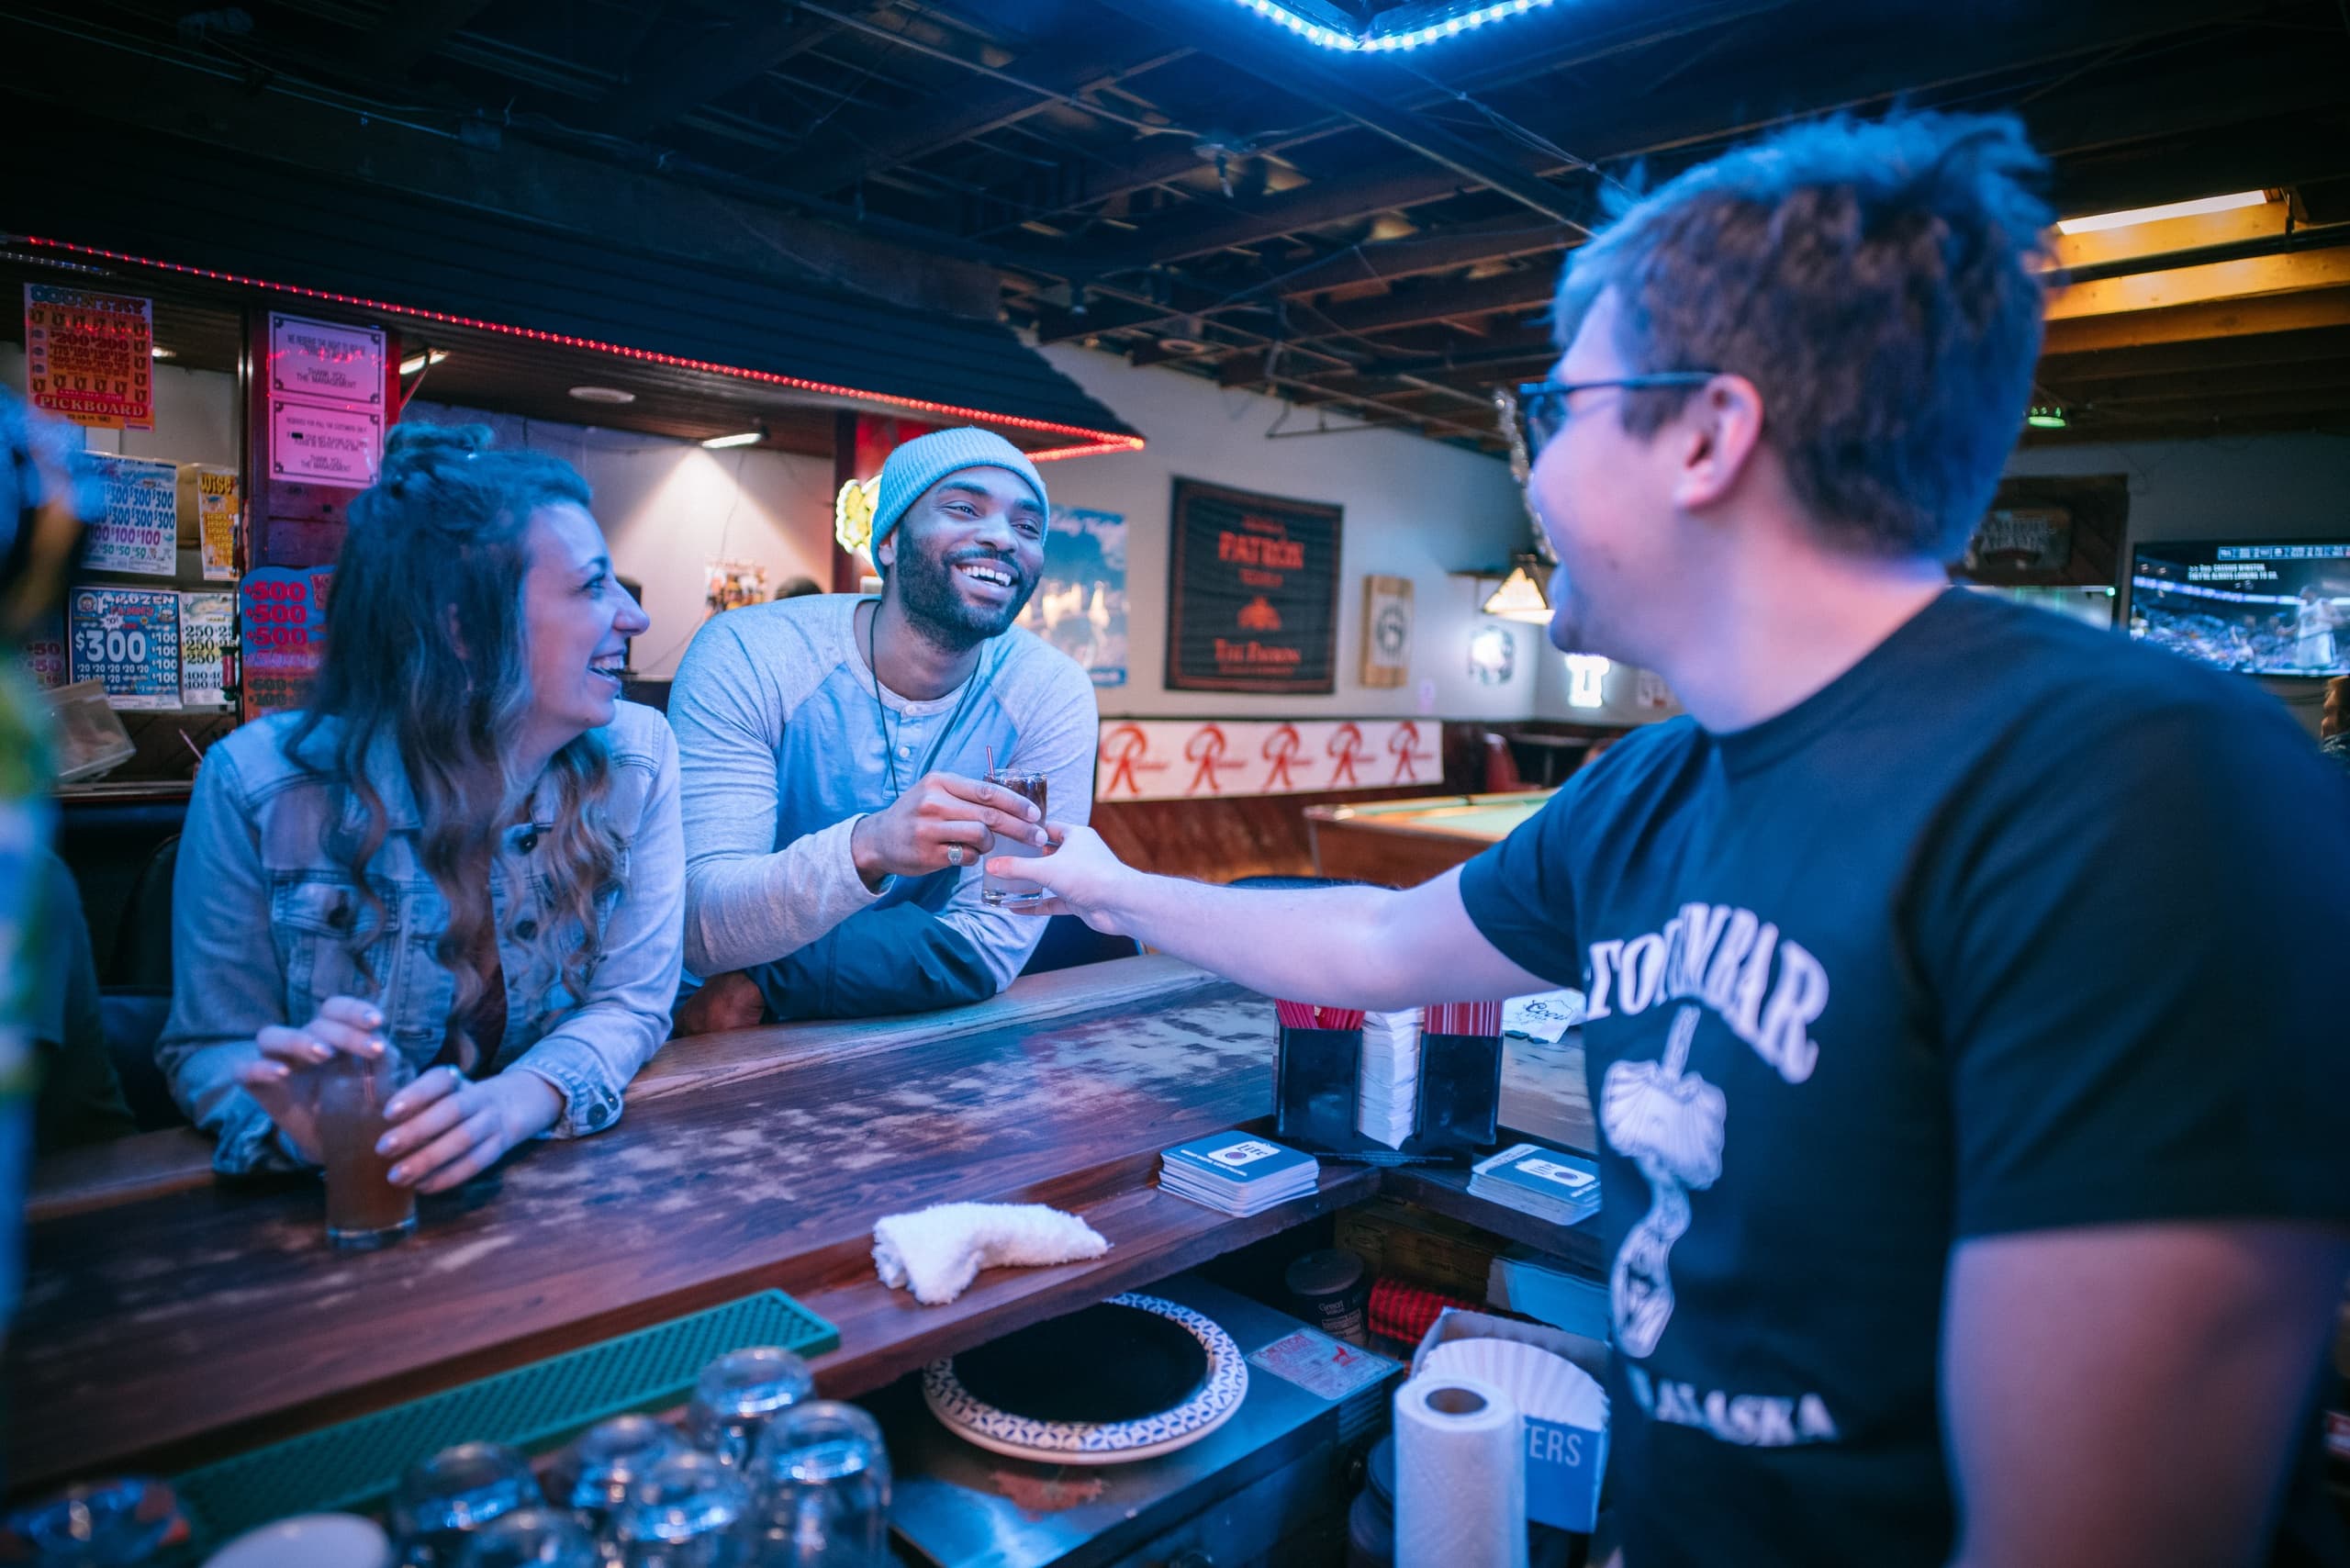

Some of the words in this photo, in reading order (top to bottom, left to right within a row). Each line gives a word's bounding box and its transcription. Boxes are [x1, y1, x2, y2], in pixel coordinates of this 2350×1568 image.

[39, 397, 145, 417] PICKBOARD
[129, 487, 151, 508] $300
[152, 489, 174, 509] $300
[108, 506, 130, 526] $300
[131, 508, 153, 528] $300
[154, 510, 175, 530] $300
[111, 527, 136, 543] $100
[137, 529, 162, 546] $100
[97, 592, 175, 614] FROZEN
[75, 630, 147, 664] $300
[151, 632, 177, 644] $100
[151, 645, 177, 657] $100
[151, 659, 177, 670] $100
[151, 672, 177, 684] $100
[1528, 1424, 1583, 1467] ERS
